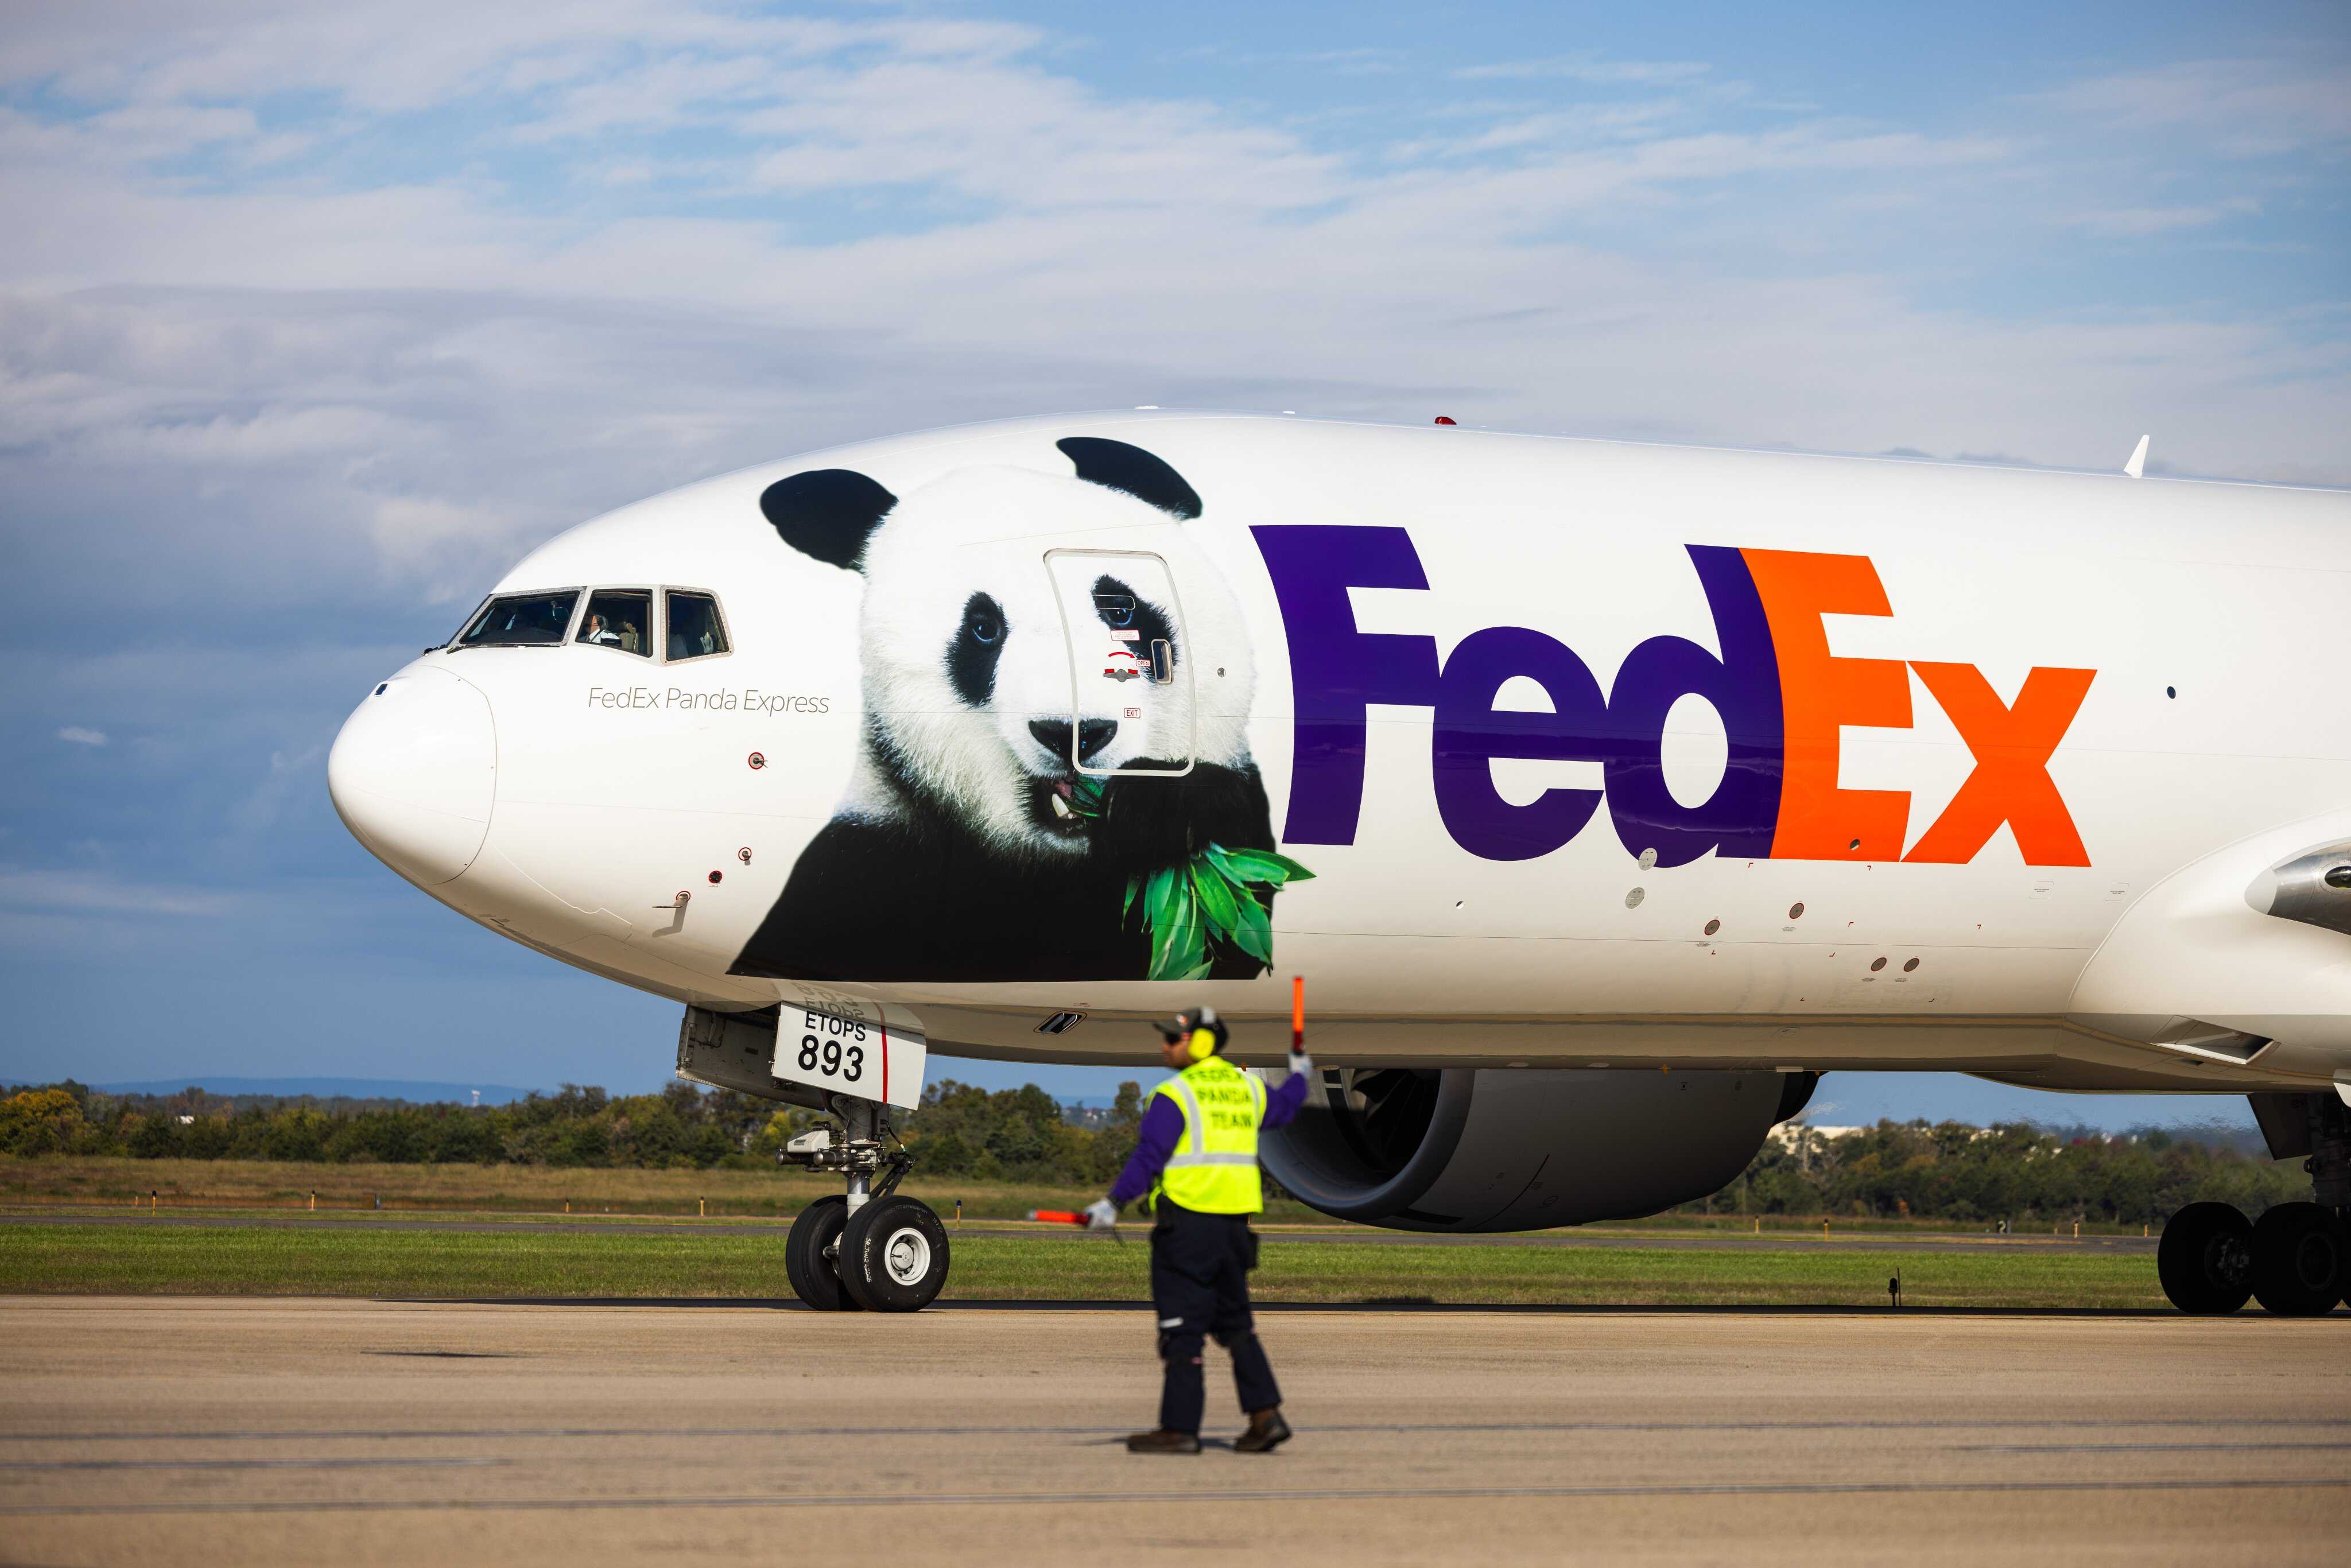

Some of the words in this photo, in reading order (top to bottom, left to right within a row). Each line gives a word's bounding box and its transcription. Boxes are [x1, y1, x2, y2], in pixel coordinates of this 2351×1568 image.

[588, 686, 661, 708] FedEx
[666, 688, 736, 710] Panda
[744, 689, 830, 717] Express
[1248, 523, 2098, 868] FedEx
[805, 1010, 866, 1042] ETOPS
[798, 1034, 864, 1082] 893
[1196, 1088, 1252, 1104] PANDA
[1211, 1111, 1252, 1130] TEAM
